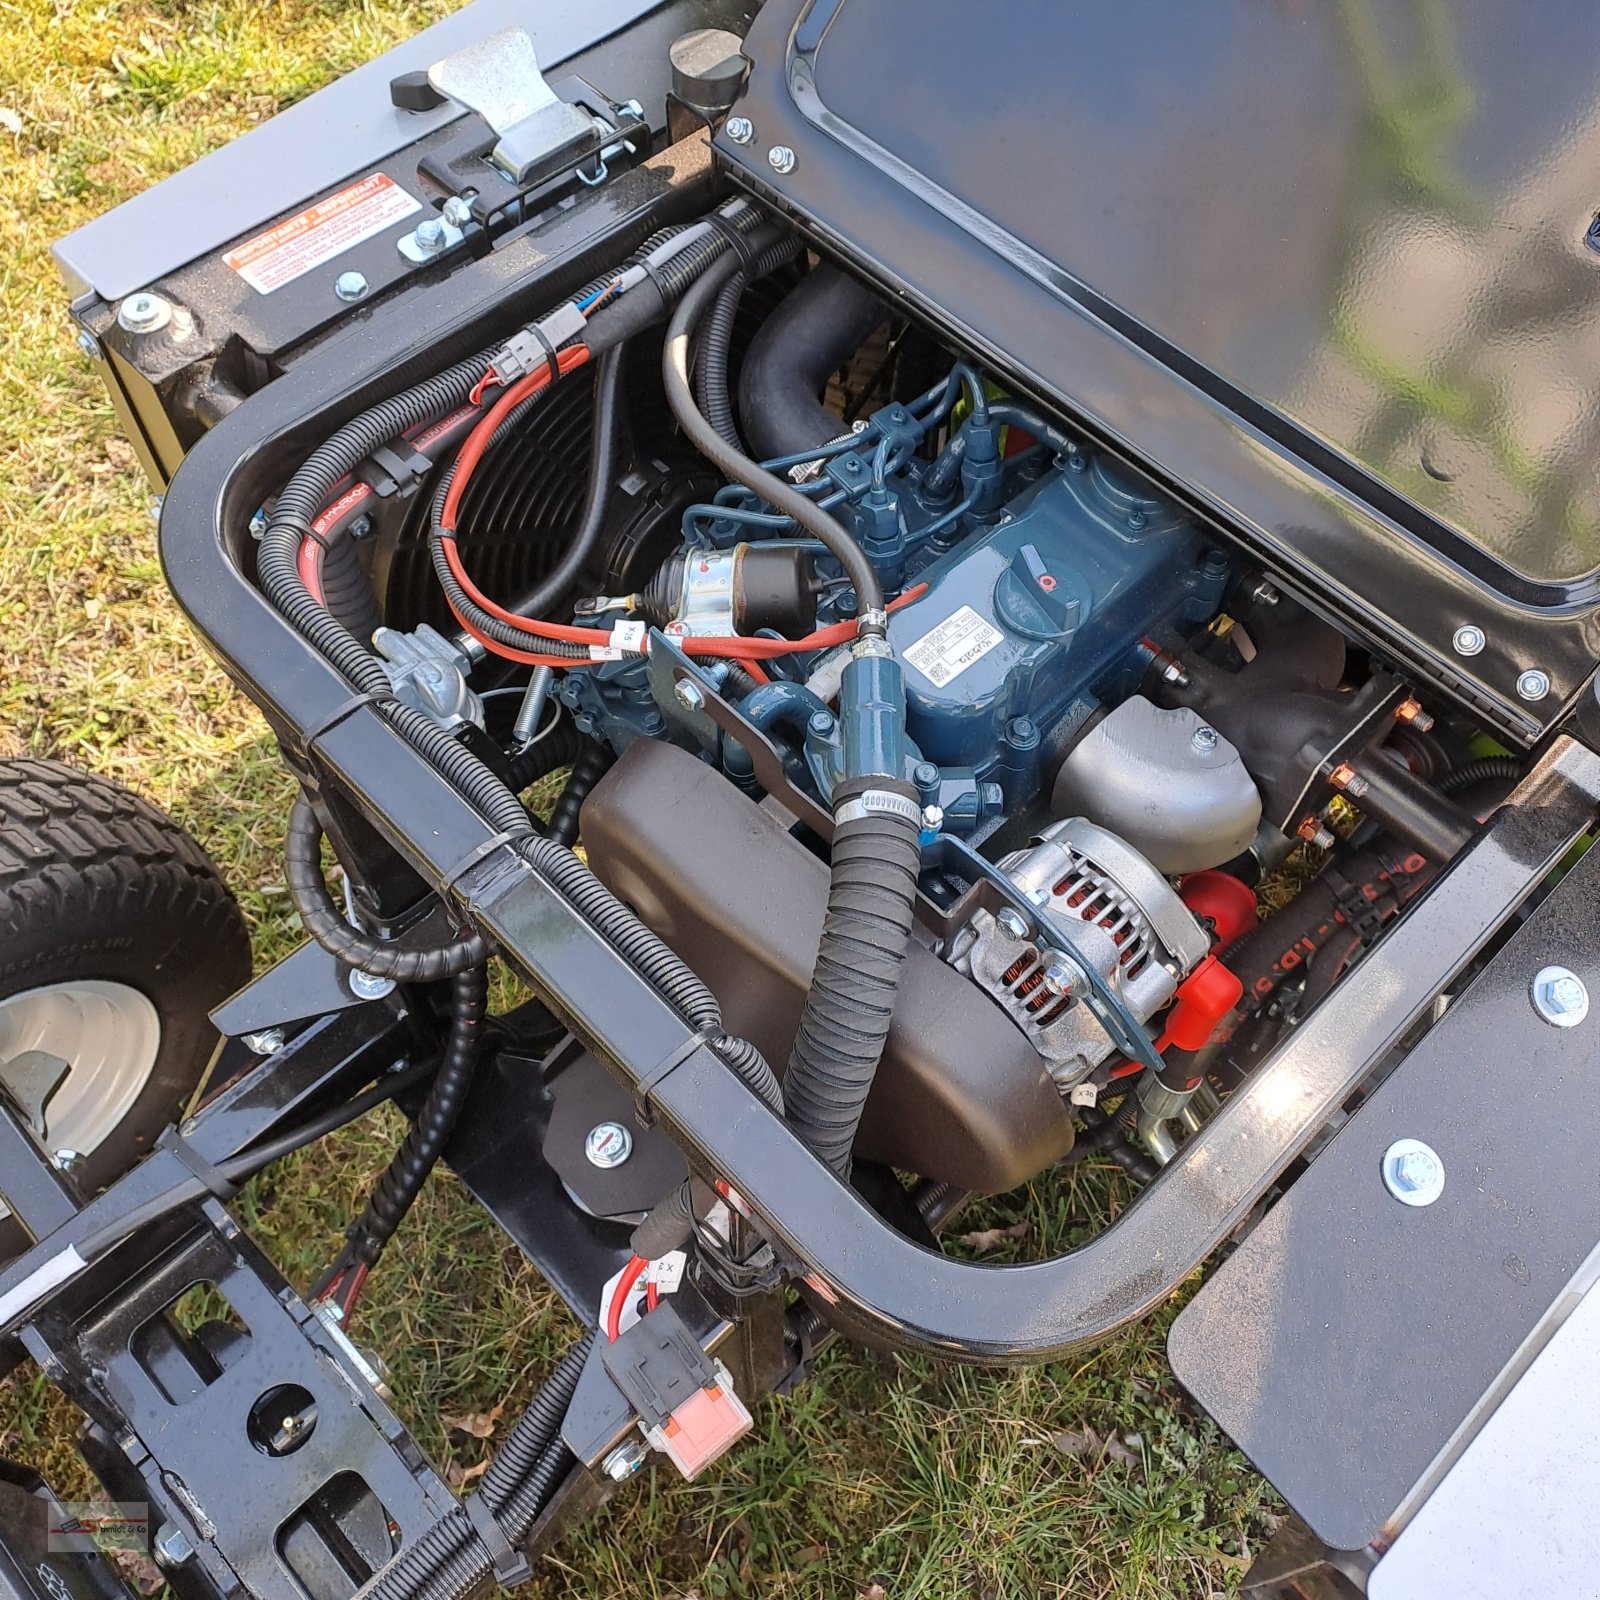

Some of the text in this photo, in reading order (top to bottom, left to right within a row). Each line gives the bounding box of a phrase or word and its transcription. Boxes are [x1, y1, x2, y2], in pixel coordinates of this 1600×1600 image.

[230, 215, 310, 260] IMPORTANTE
[314, 177, 381, 215] IMPORTANT
[971, 627, 990, 642] D722
[958, 637, 992, 665] Kubota
[1272, 937, 1316, 970] I.D.
